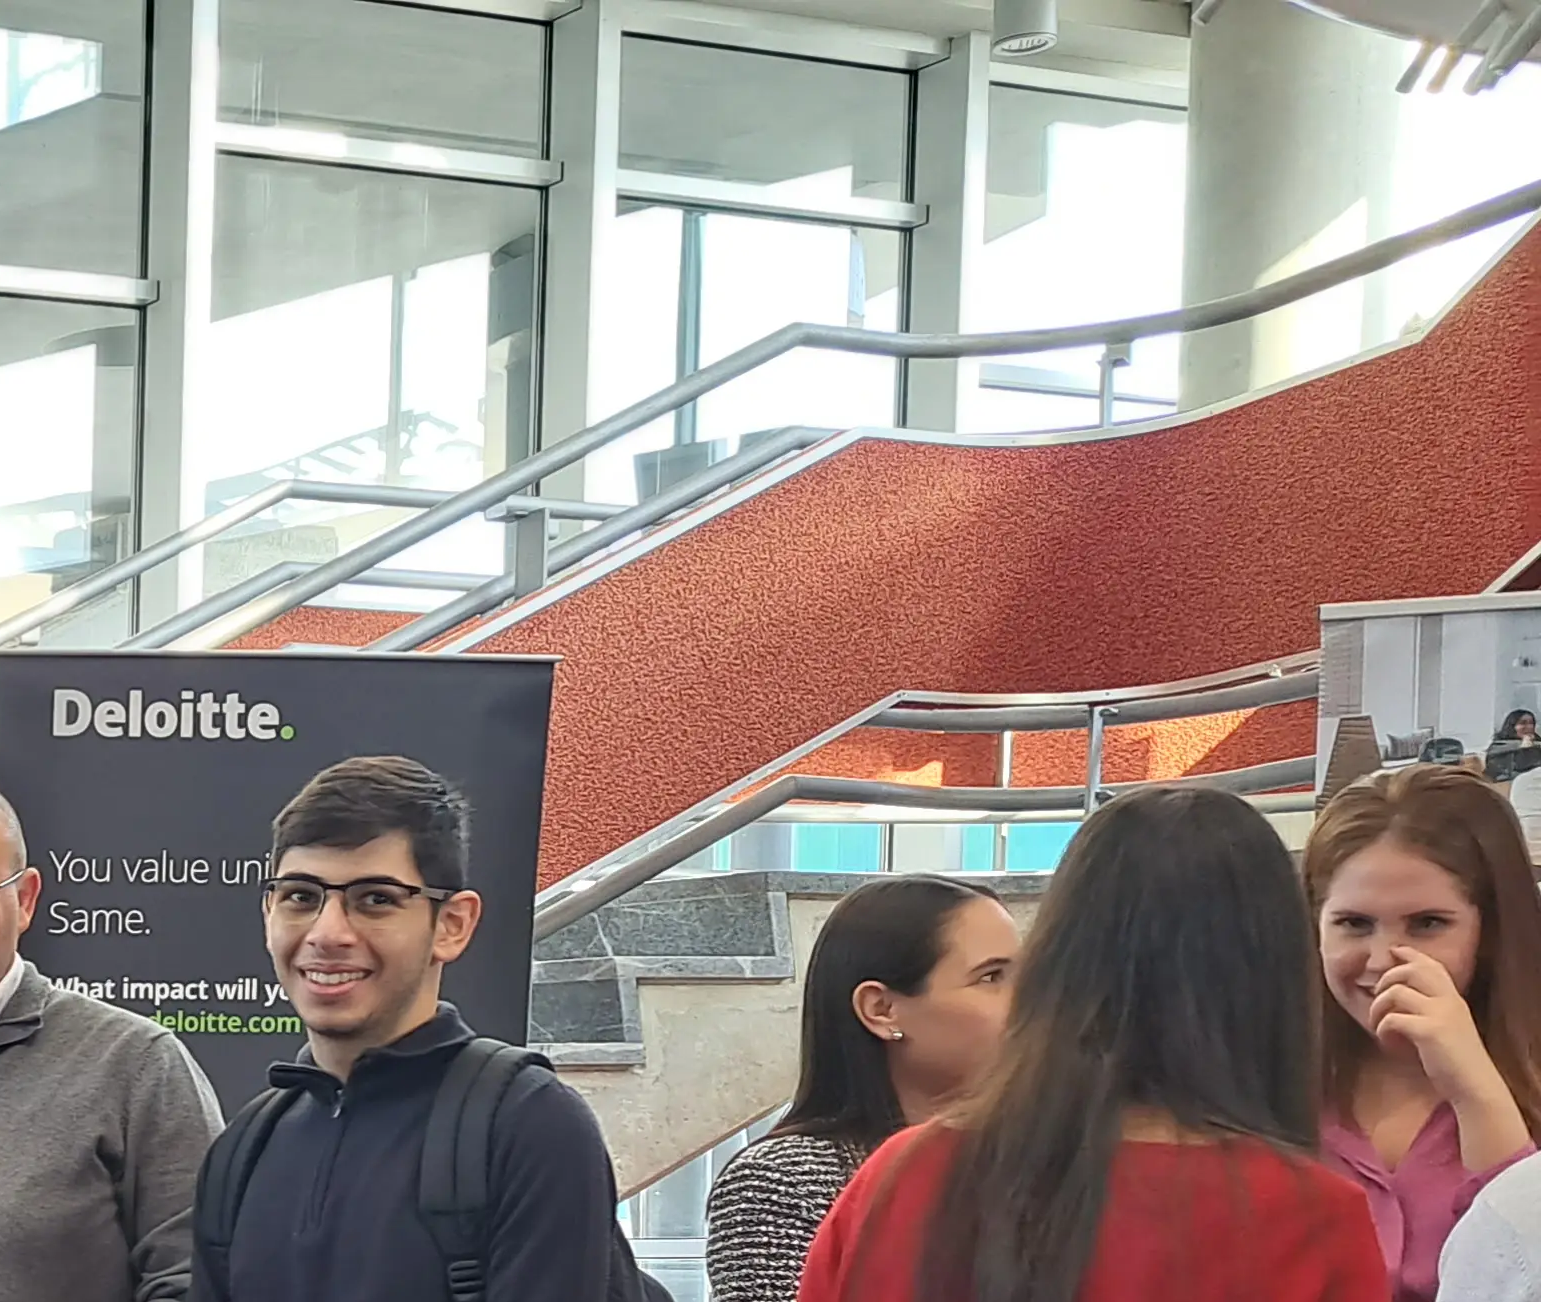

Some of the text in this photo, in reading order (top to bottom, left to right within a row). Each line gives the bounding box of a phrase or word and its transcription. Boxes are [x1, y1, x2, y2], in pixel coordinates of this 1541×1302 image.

[48, 849, 111, 884] You
[121, 849, 210, 884] value
[47, 901, 152, 935] Same.
[121, 977, 209, 1006] impact
[215, 977, 258, 1001] will
